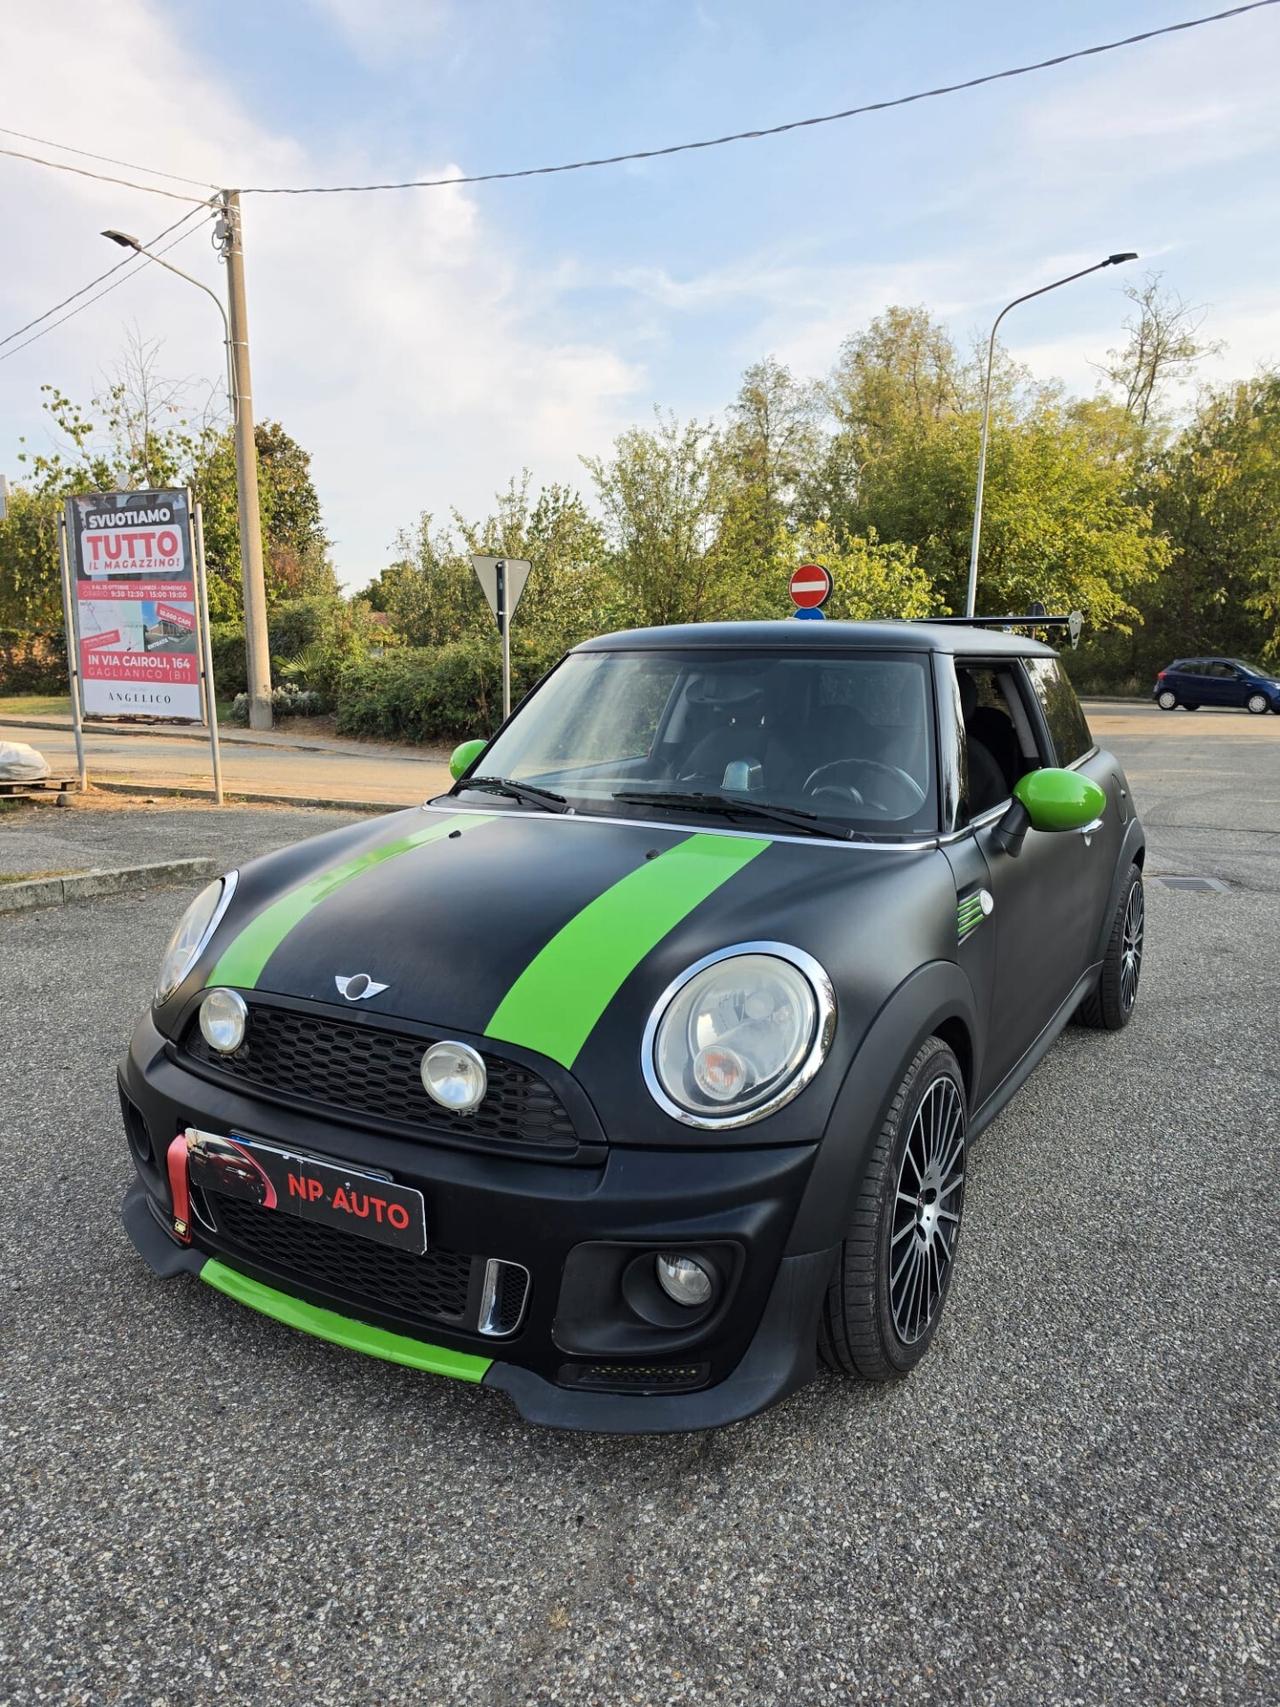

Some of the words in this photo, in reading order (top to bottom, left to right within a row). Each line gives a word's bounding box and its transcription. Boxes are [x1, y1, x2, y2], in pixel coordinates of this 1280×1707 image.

[88, 508, 171, 528] SVUOTIAMO
[86, 531, 178, 560] TUTTO
[88, 561, 99, 570] IL
[104, 558, 180, 570] MAGAZZINO!
[88, 655, 99, 665] IN
[101, 655, 120, 666] VIA
[122, 656, 170, 670] CAIROLI,
[172, 657, 191, 669] 164
[88, 667, 163, 679] GAGLIANICO
[108, 692, 171, 704] ANGELICO
[287, 1172, 324, 1202] NP
[332, 1187, 410, 1230] AUTO
